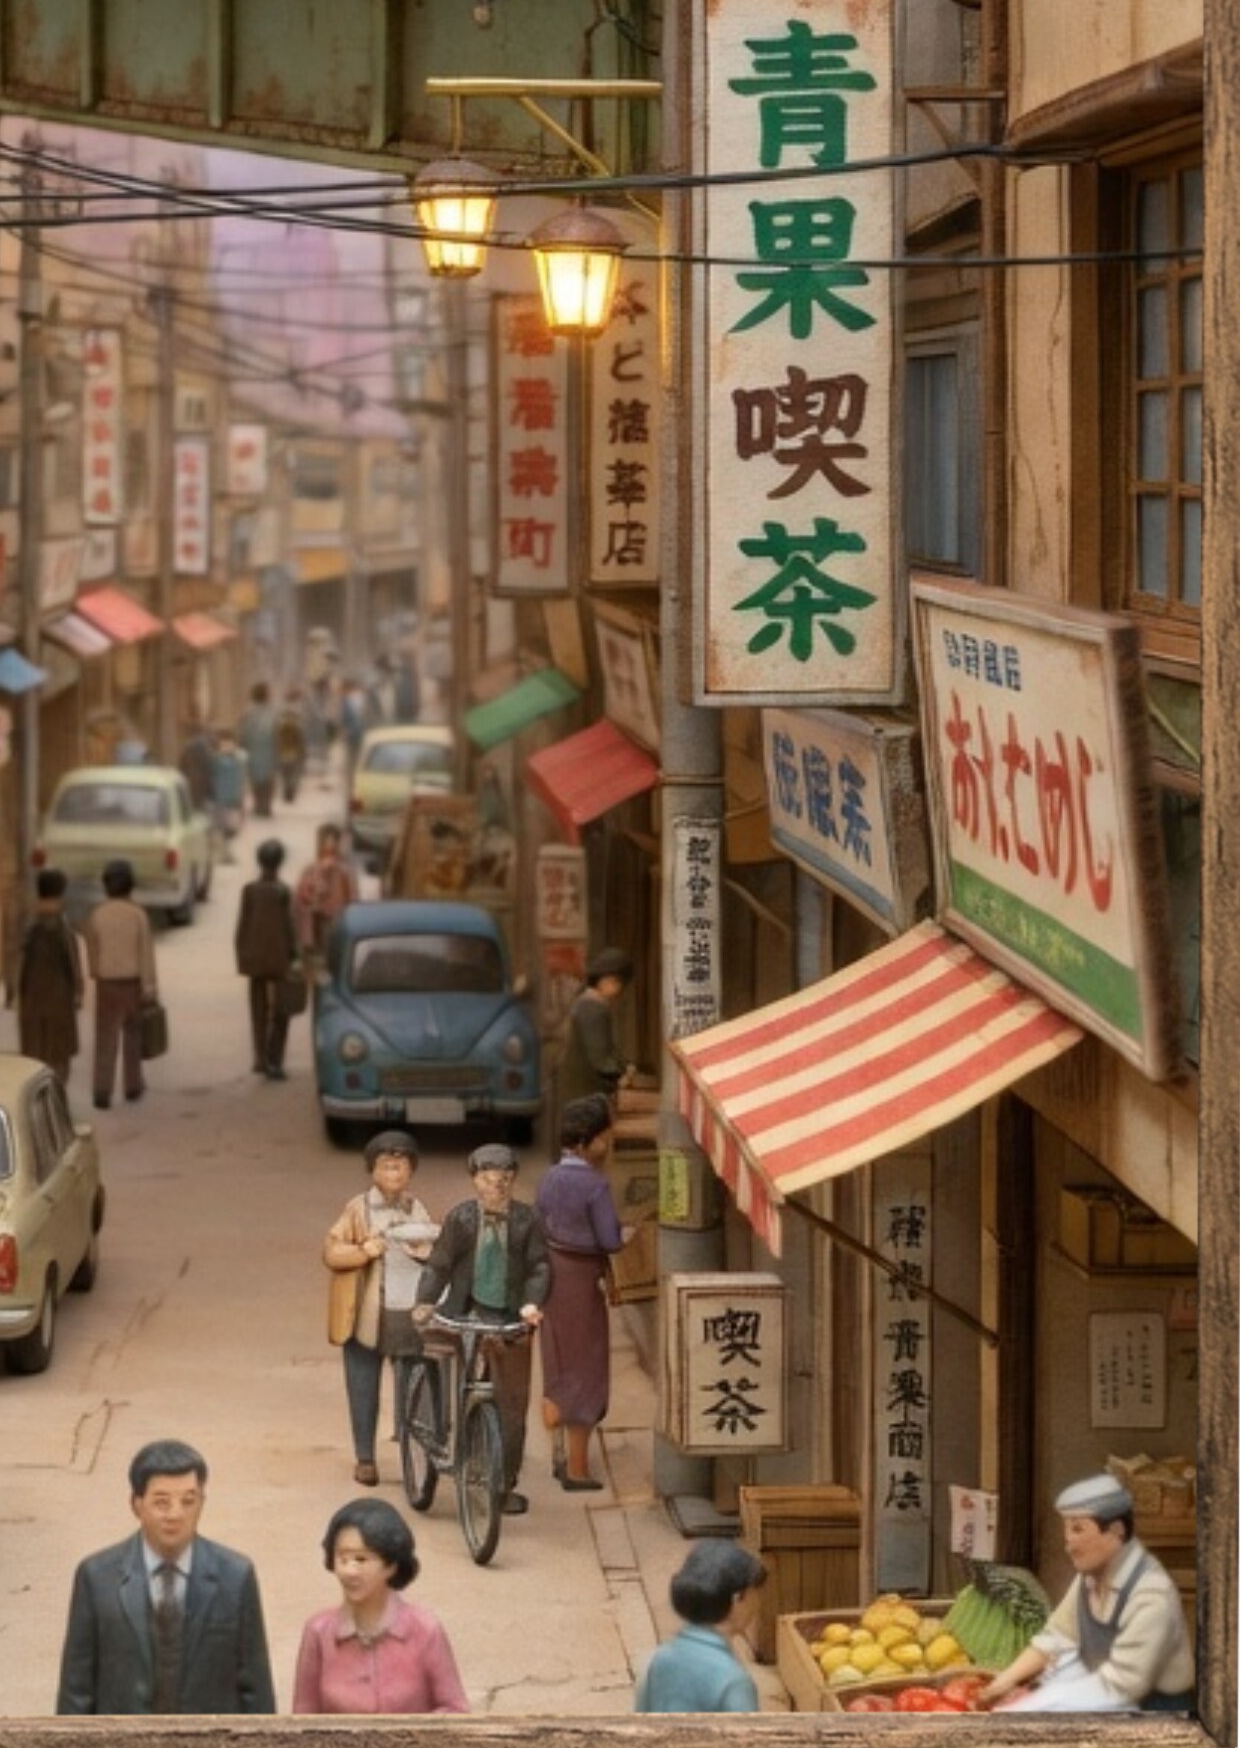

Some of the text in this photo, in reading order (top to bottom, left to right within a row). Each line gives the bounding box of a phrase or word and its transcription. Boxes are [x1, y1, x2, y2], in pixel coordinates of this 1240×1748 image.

[727, 19, 878, 662] 青果喫茶
[702, 1307, 767, 1436] 喫茶
